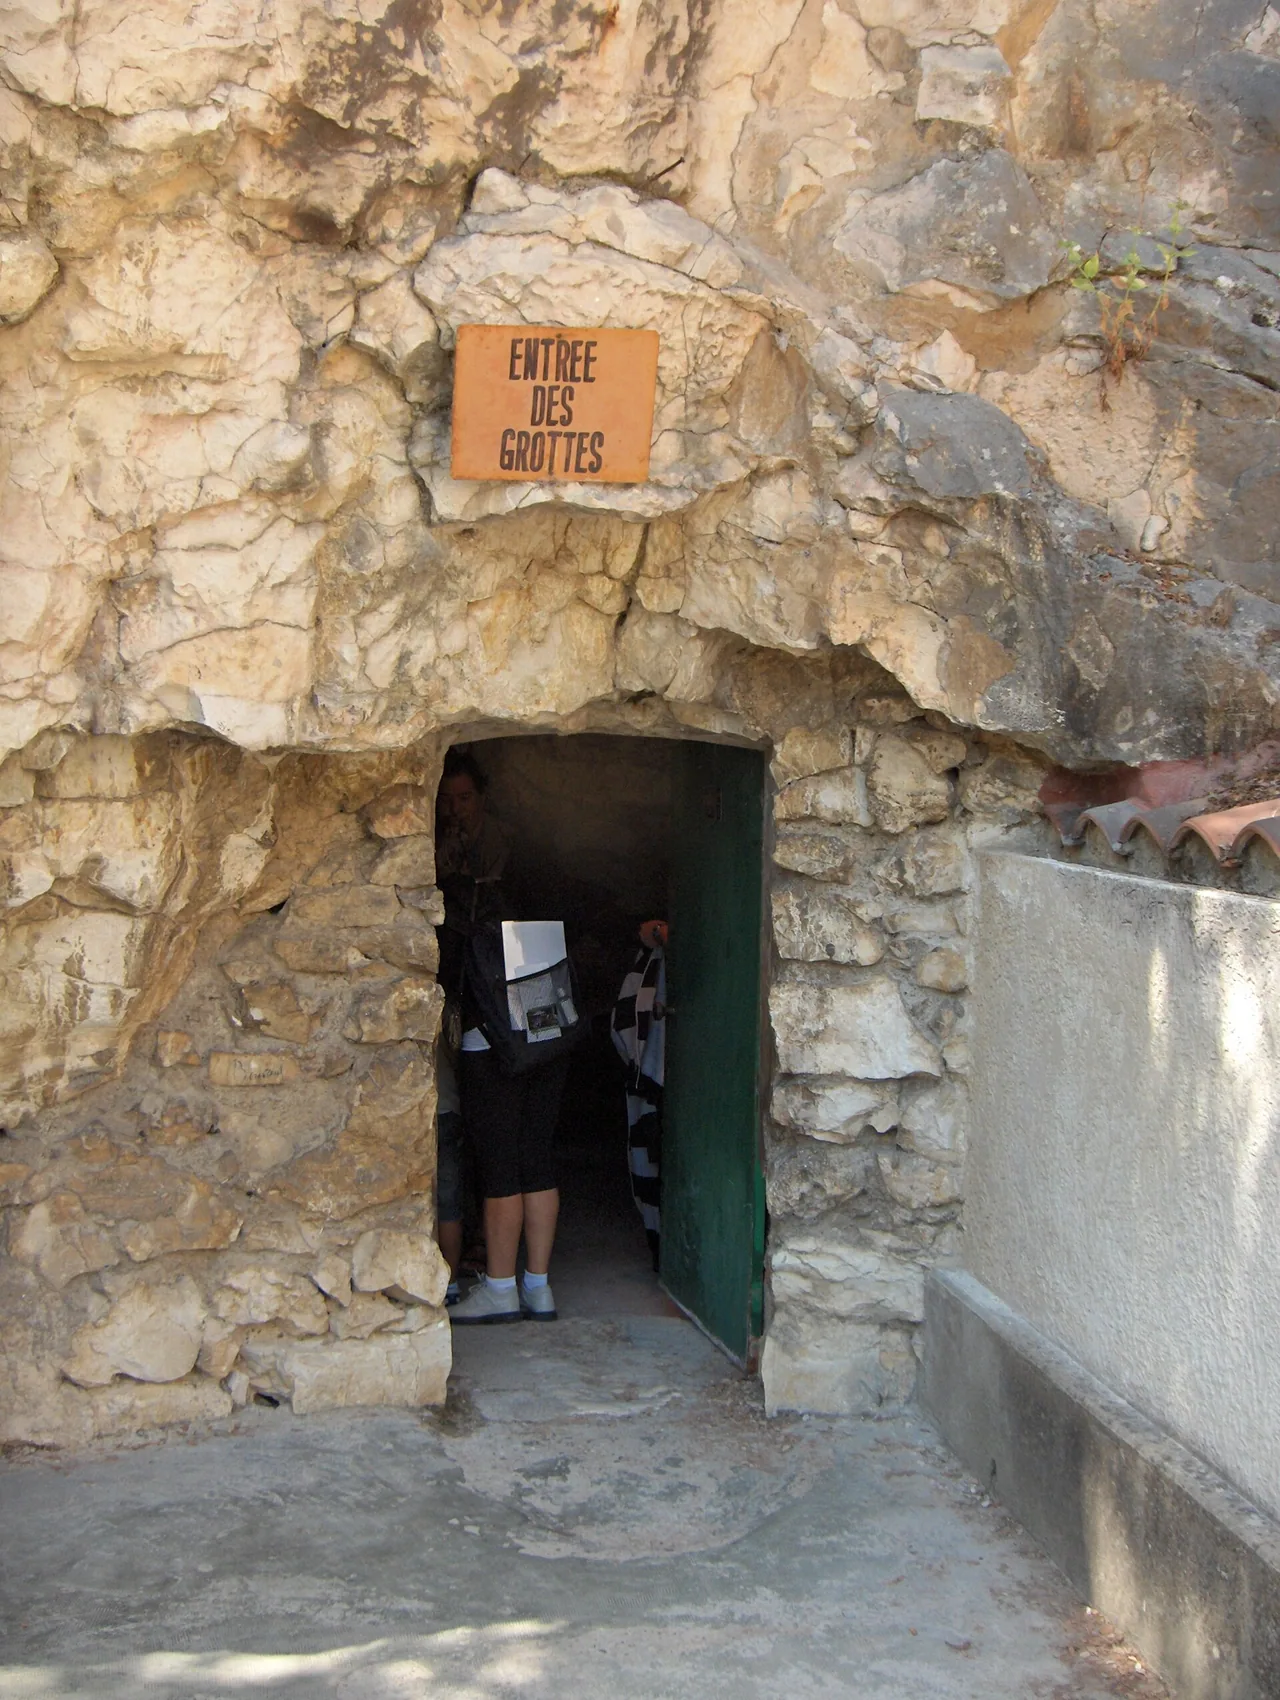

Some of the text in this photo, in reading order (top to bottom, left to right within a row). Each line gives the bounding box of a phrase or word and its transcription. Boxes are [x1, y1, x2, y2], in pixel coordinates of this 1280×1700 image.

[509, 337, 598, 383] ENTREE
[530, 384, 575, 427] DES
[499, 428, 605, 474] GROTTES
